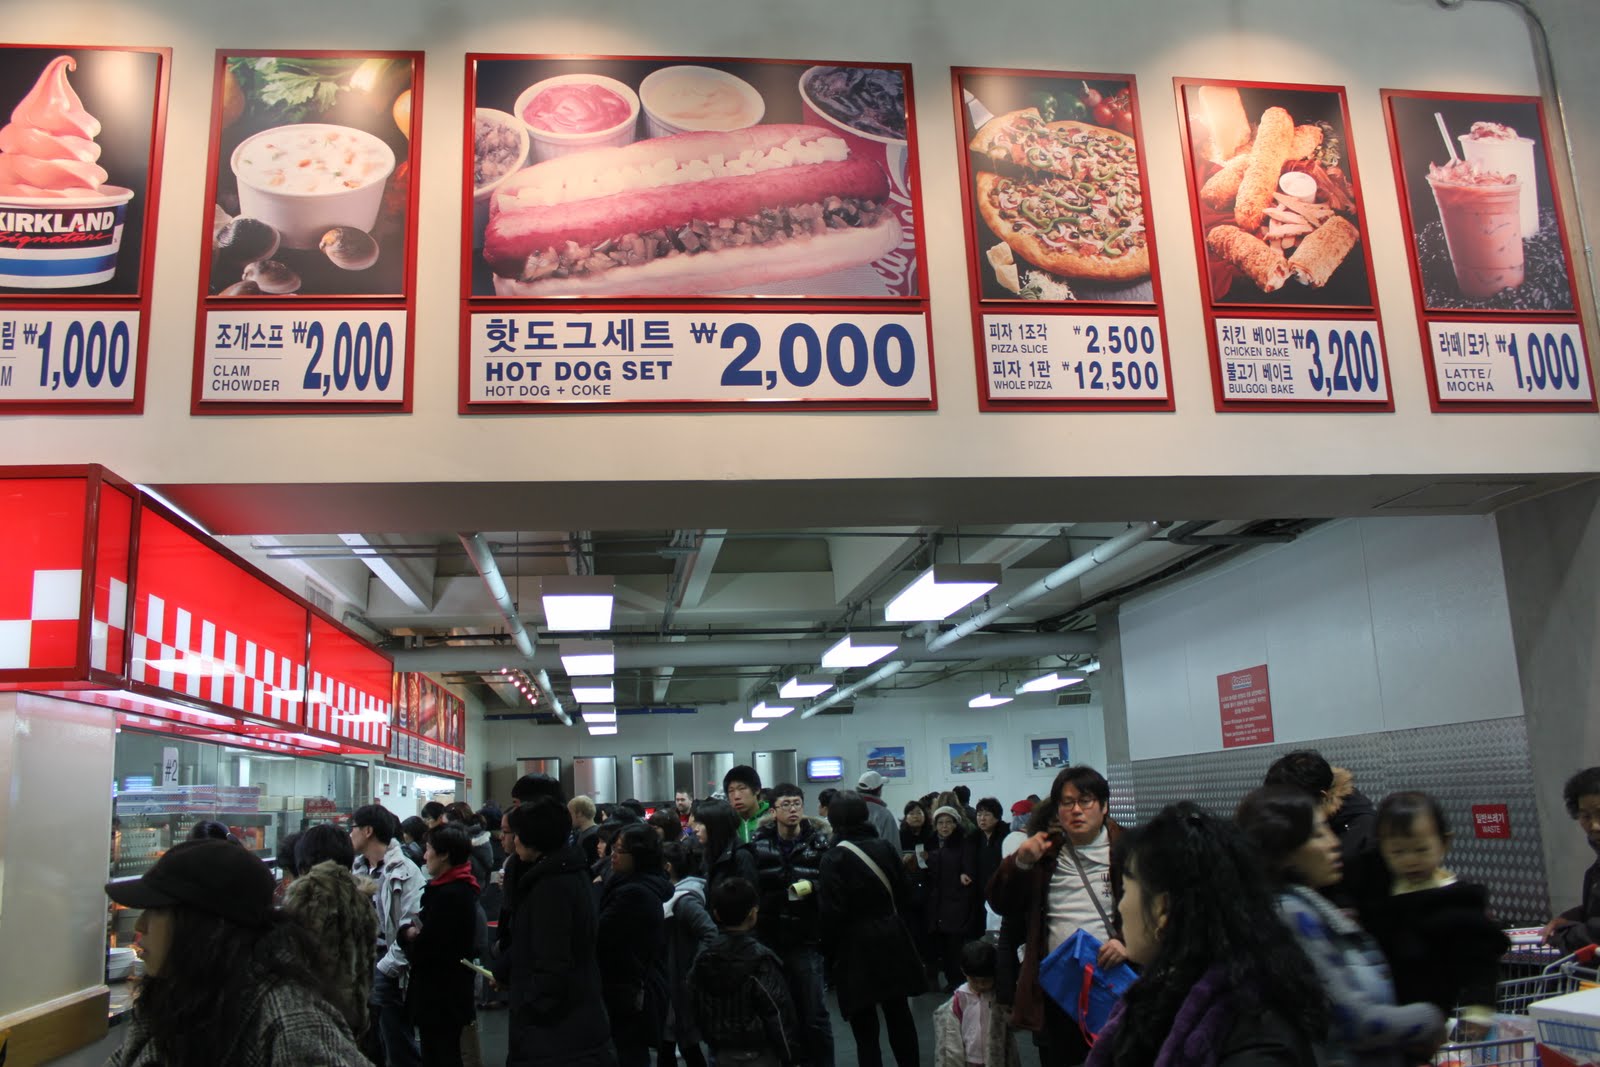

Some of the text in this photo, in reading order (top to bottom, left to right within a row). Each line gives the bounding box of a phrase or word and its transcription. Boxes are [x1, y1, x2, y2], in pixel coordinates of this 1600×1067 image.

[215, 323, 283, 350] 조개스프
[486, 319, 673, 352] 핫도그세트
[990, 323, 1012, 340] 피자
[1019, 324, 1047, 340] 1조각
[1223, 326, 1288, 345] 치킨 베이크
[23, 321, 129, 390] ₩1,000
[690, 323, 915, 390] ₩2,000
[992, 344, 1048, 353] PIZZA SLICE
[1224, 347, 1289, 357] CHICKEN BAKE
[292, 321, 393, 396] ₩2,000
[1292, 328, 1379, 397] ₩3,200
[1495, 333, 1580, 392] ₩1,000
[214, 365, 249, 376] CLAM
[486, 361, 672, 381] HOT DOG SET
[993, 360, 1021, 377] 피자
[1030, 361, 1050, 377] 1판
[1227, 363, 1293, 381] 불고기 베이크
[212, 380, 279, 391] CHOWDER
[486, 386, 514, 396] HOT
[520, 385, 549, 396] DOG
[572, 385, 610, 395] COKE
[994, 381, 1052, 389] WHOLE PIZZA
[1229, 384, 1294, 393] BULGOGI BAKE
[1447, 382, 1494, 391] MOCHA
[165, 759, 178, 782] #2
[1481, 825, 1502, 834] WASTE
